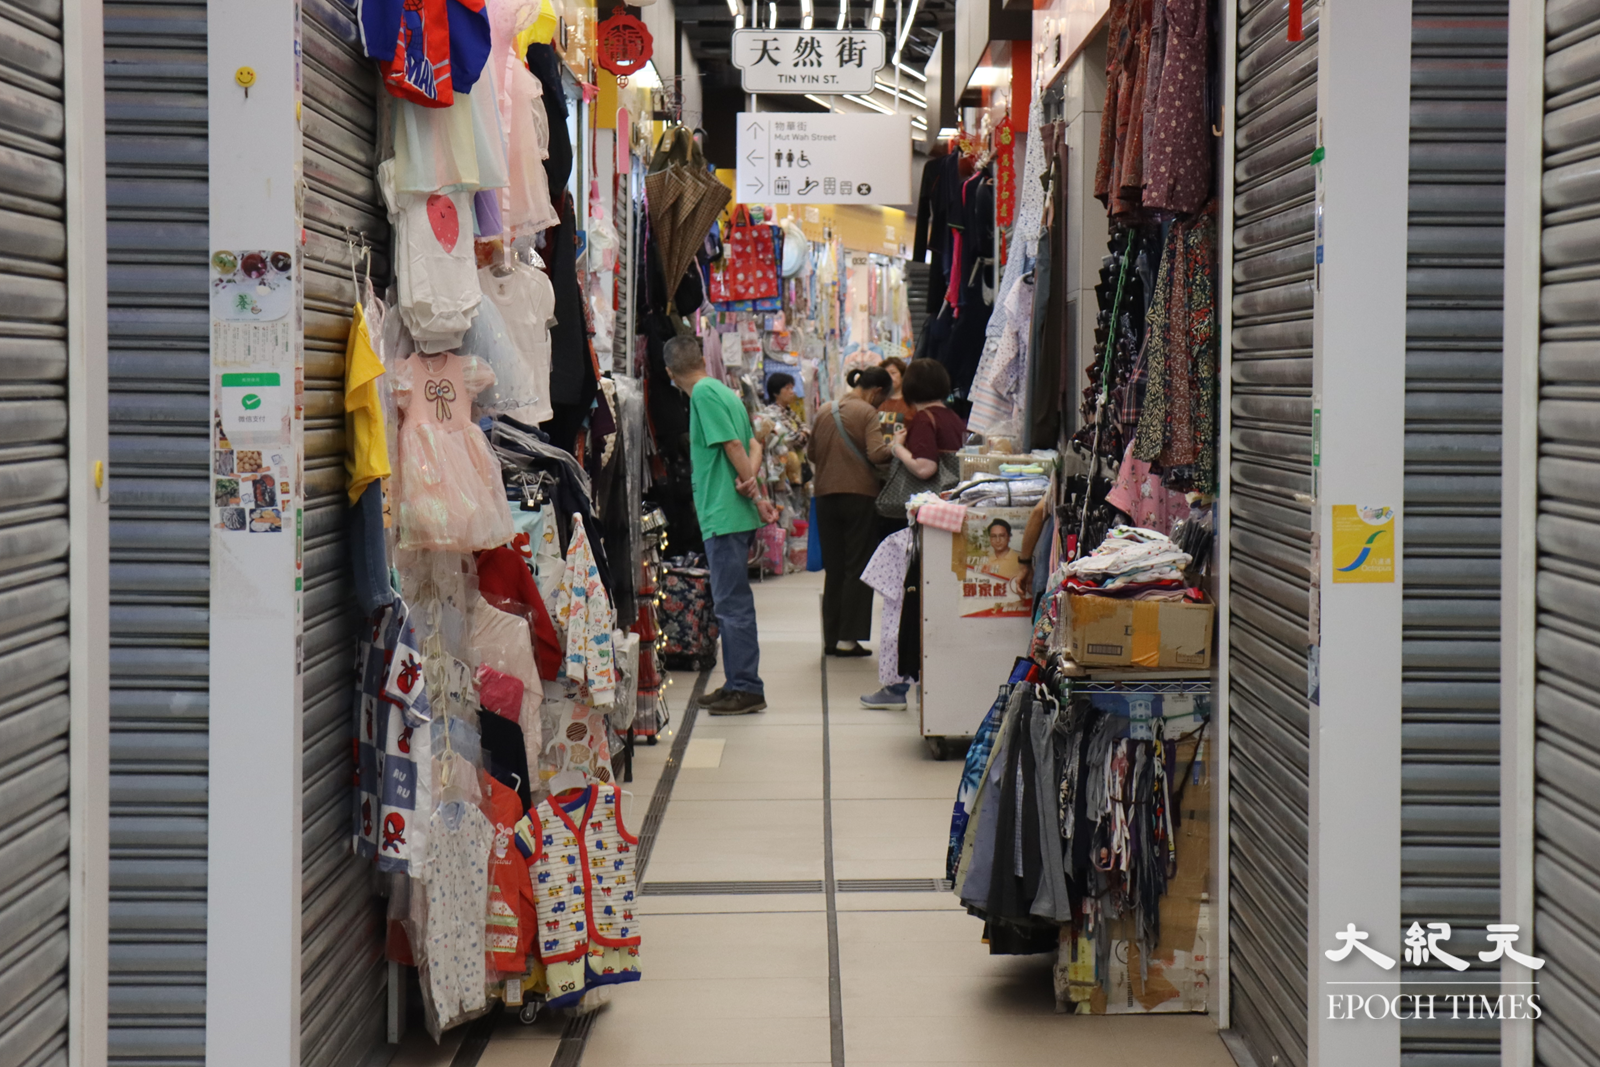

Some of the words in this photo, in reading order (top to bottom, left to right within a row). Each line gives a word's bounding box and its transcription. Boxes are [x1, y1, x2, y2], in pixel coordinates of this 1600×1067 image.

[750, 36, 867, 68] 天然街
[777, 74, 797, 84] TIN
[799, 74, 819, 84] YIN
[823, 74, 839, 84] ST.
[774, 121, 807, 132] 物華街
[774, 133, 791, 141] Mut
[792, 133, 810, 141] Wah
[811, 133, 836, 141] Street
[238, 415, 266, 423] 微信支付
[1361, 564, 1392, 573] Octopus
